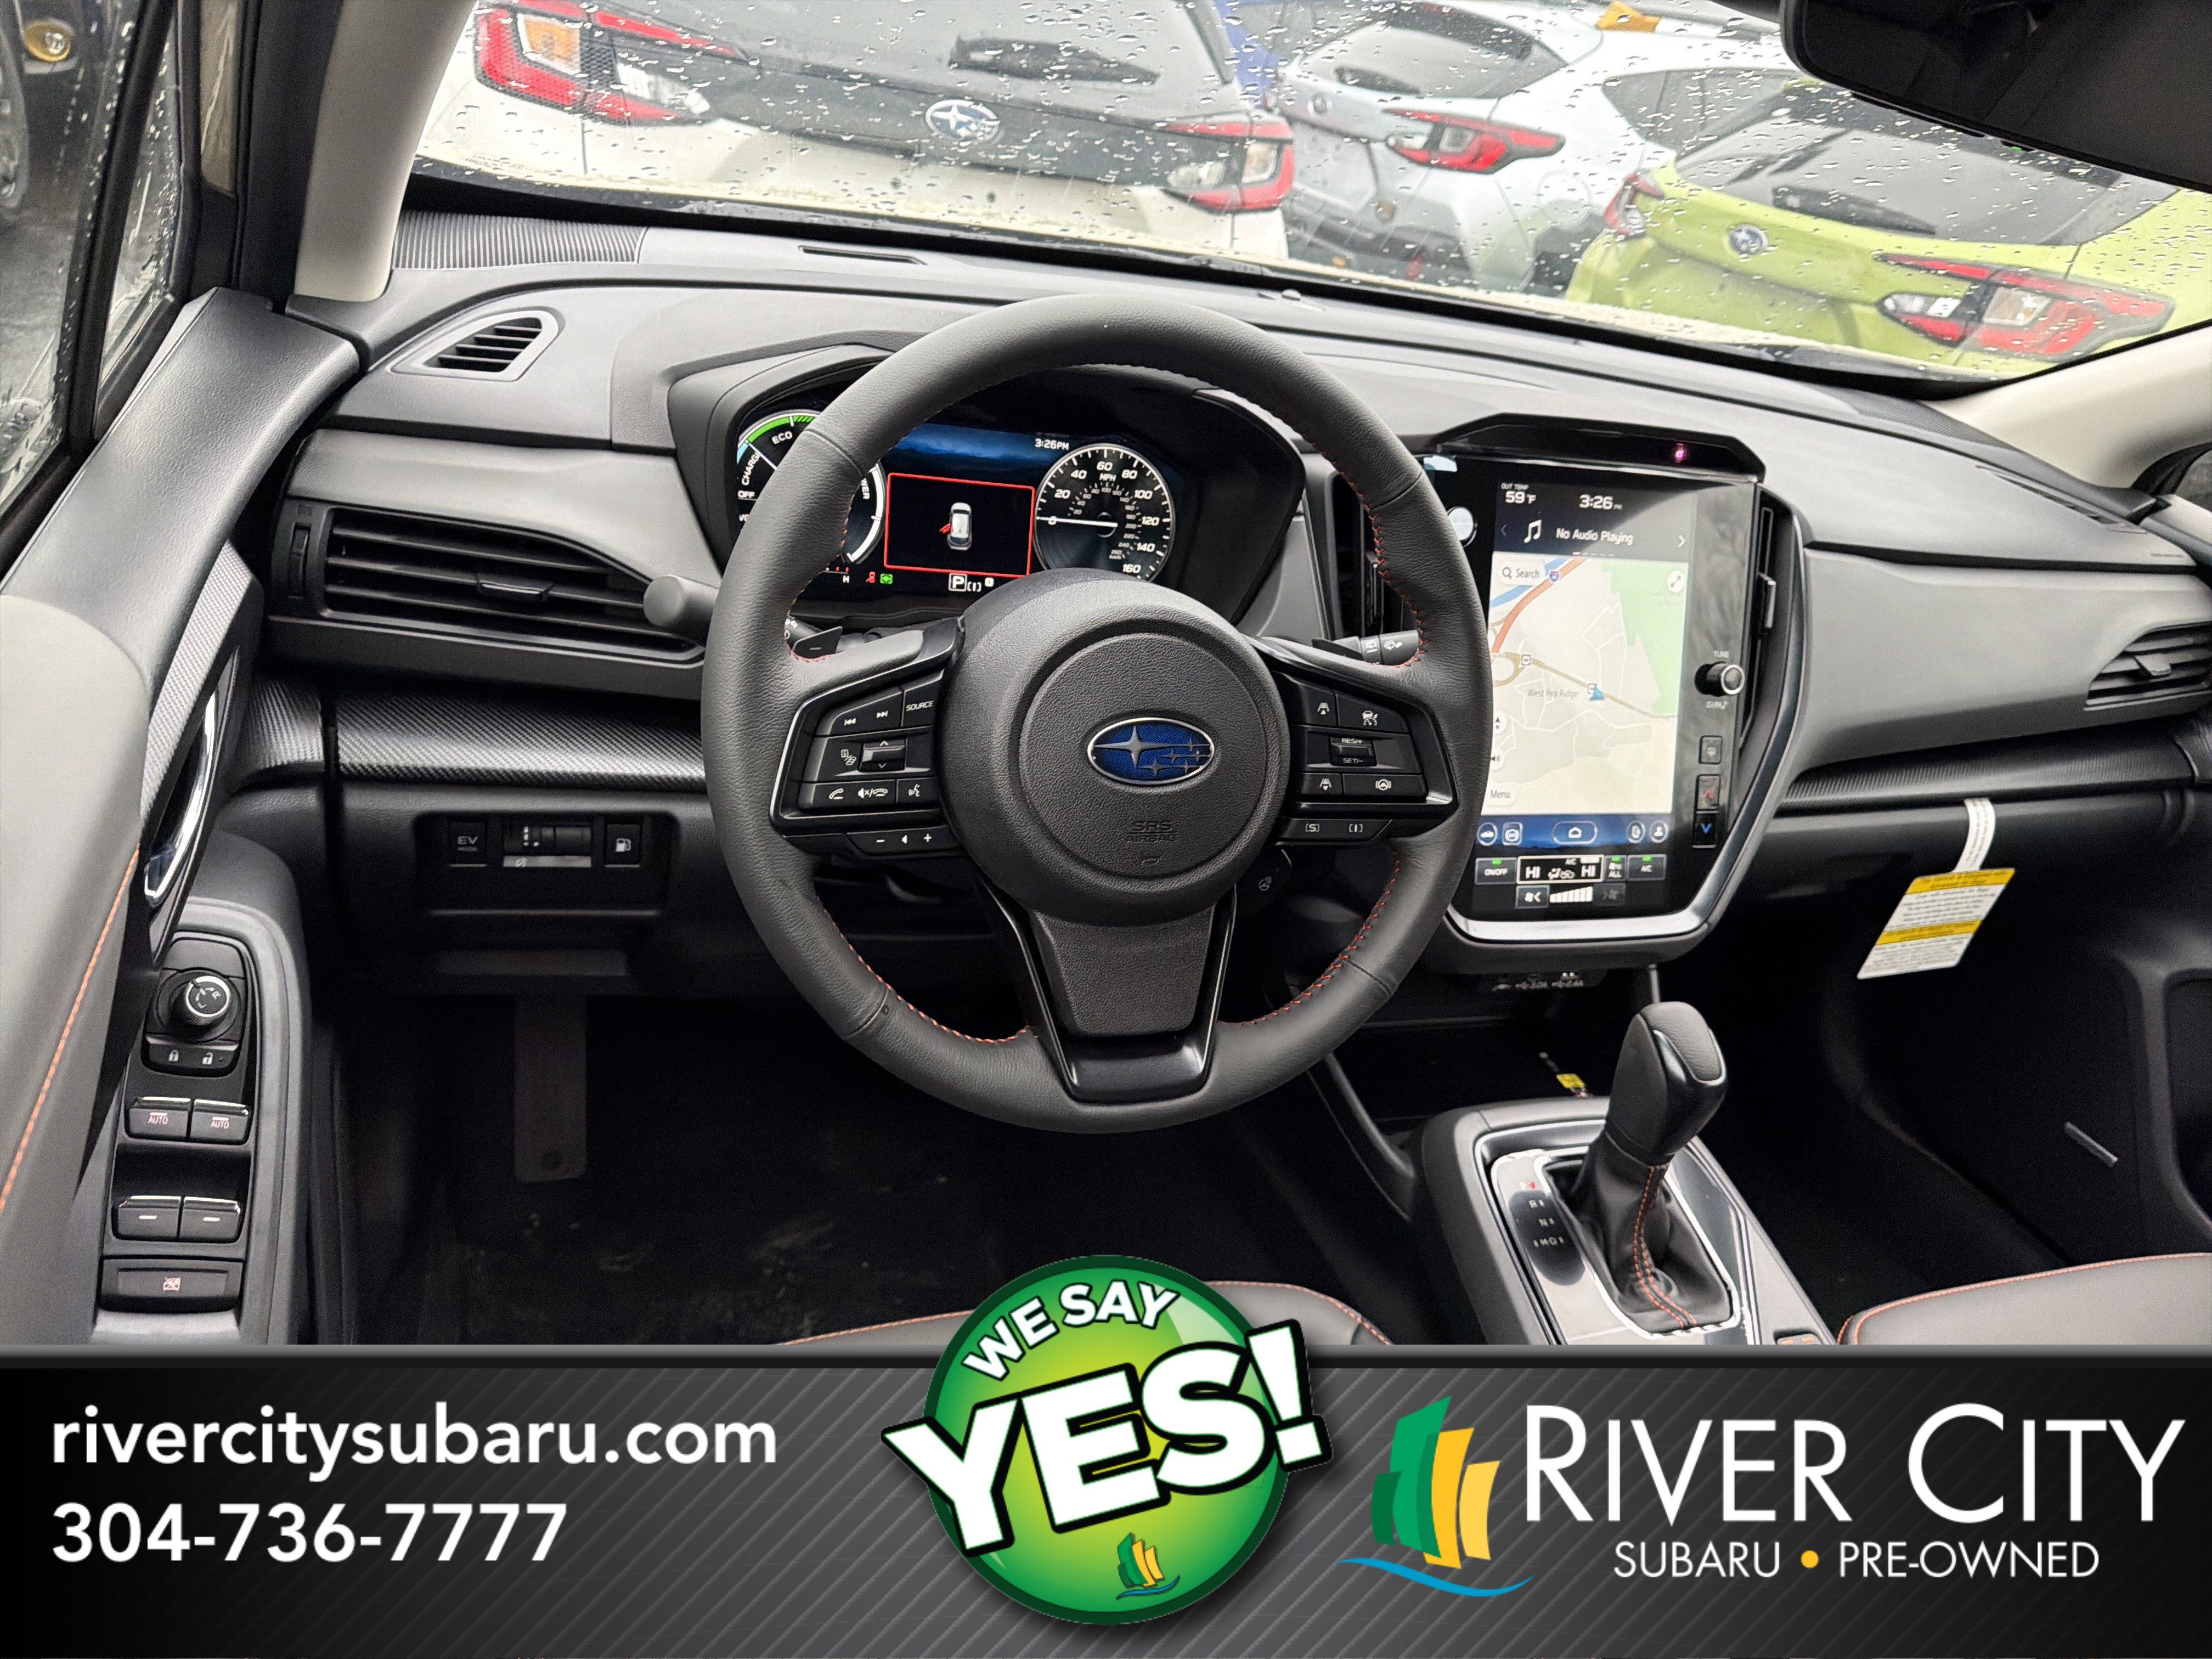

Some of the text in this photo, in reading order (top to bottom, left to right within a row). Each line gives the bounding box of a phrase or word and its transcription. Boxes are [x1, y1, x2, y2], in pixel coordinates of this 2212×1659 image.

[771, 431, 793, 444] ECO
[1035, 438, 1069, 450] 3:26PM
[741, 452, 760, 486] CHARG
[1097, 461, 1113, 471] 60
[1071, 470, 1087, 479] 40
[1099, 473, 1116, 482] MPH
[1121, 469, 1138, 479] 80
[737, 490, 755, 499] OFF
[1054, 489, 1071, 499] 20
[1134, 490, 1153, 499] 100
[1505, 490, 1526, 504] 59
[1579, 494, 1614, 510] 3:26
[1142, 516, 1160, 526] 120
[1556, 527, 1633, 545] No Audio Playing
[1136, 542, 1155, 552] 140
[1122, 563, 1141, 574] 160
[1515, 568, 1539, 579] Search
[843, 575, 850, 583] H
[906, 700, 934, 712] SOURCE
[1489, 789, 1511, 799] Menu
[457, 836, 478, 845] EV
[1525, 866, 1541, 879] HI
[1581, 865, 1596, 878] HI
[148, 1115, 169, 1125] AUTO
[210, 1120, 229, 1130] AUTO
